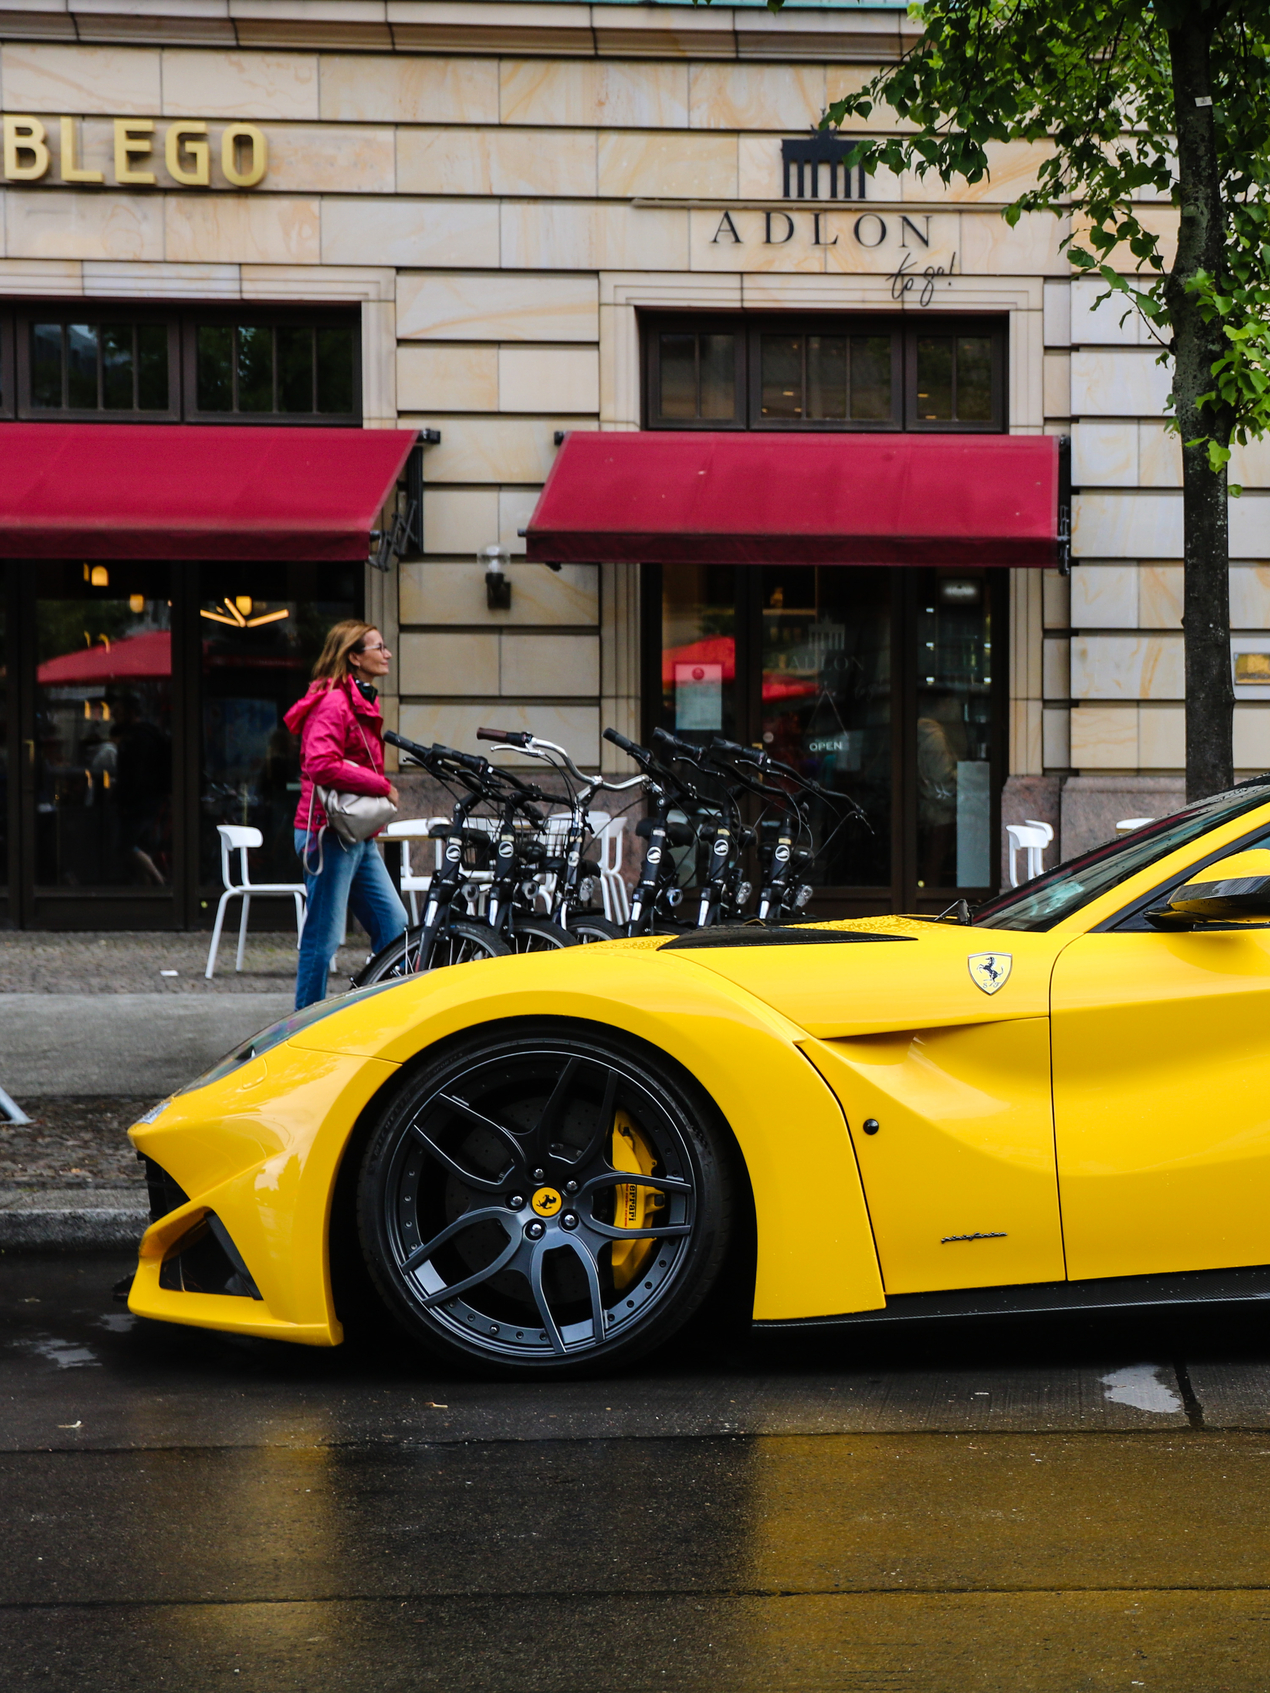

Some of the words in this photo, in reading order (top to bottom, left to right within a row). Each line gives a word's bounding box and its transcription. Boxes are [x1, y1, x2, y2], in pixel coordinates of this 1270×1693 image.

[4, 114, 268, 187] BLEGO
[711, 210, 932, 248] ADLON
[885, 252, 917, 300] to
[809, 741, 842, 752] OPEN
[628, 1184, 638, 1221] errari
